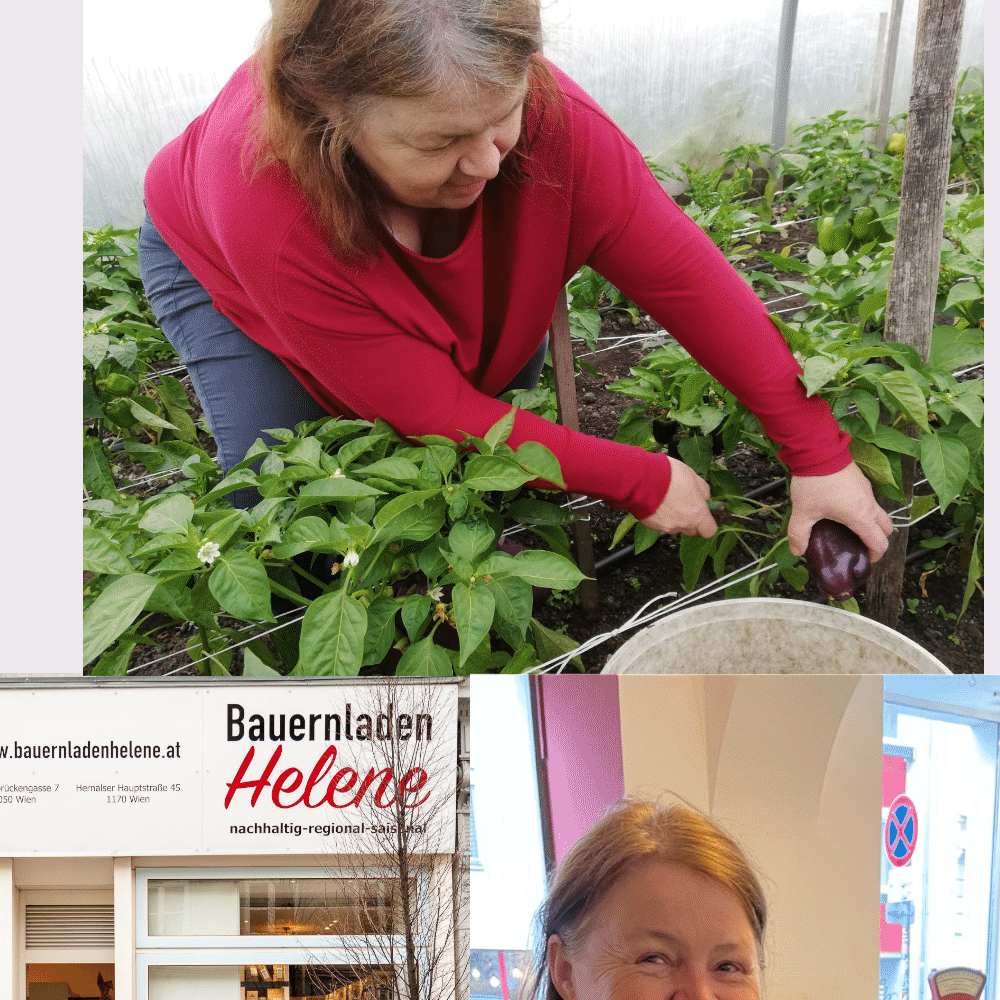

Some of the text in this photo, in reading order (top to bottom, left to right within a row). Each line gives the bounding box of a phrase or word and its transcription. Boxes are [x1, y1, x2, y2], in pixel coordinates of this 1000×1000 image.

[227, 703, 433, 742] Bauernladen
[223, 744, 431, 810] Helene
[54, 784, 60, 792] 7
[75, 783, 181, 793] Hernalser Hauptstraße 45
[15, 795, 36, 804] Wien
[106, 795, 150, 803] 1170 Wien
[229, 822, 427, 837] nachhaltig-regional-saisnal
